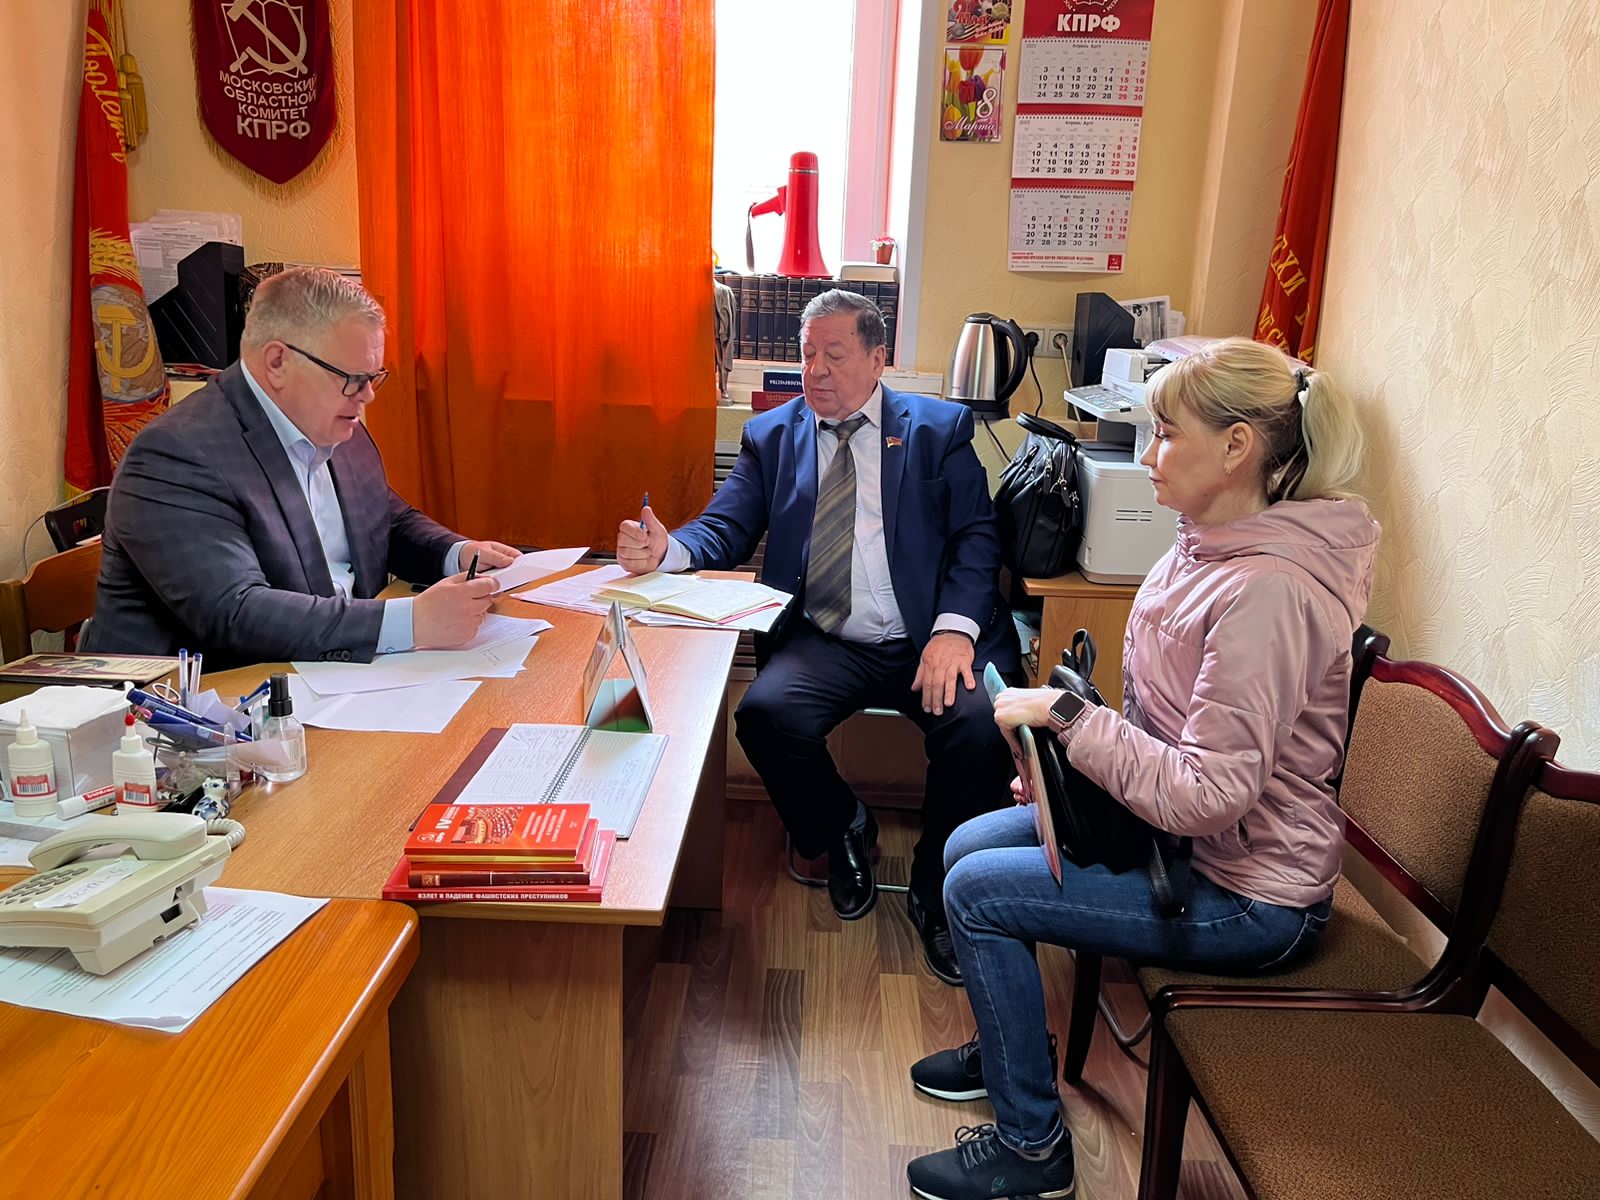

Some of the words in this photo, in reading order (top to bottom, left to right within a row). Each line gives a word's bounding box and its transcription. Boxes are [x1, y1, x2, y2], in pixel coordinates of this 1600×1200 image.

[1057, 14, 1121, 32] КПРФ
[220, 70, 317, 94] МОСКОВСКИЙ
[224, 86, 316, 108] ОБЛАСТНОЙ
[976, 88, 998, 119] 8
[238, 102, 308, 120] КОМИТЕТ
[236, 114, 311, 140] КПРФ
[944, 115, 995, 136] Марта
